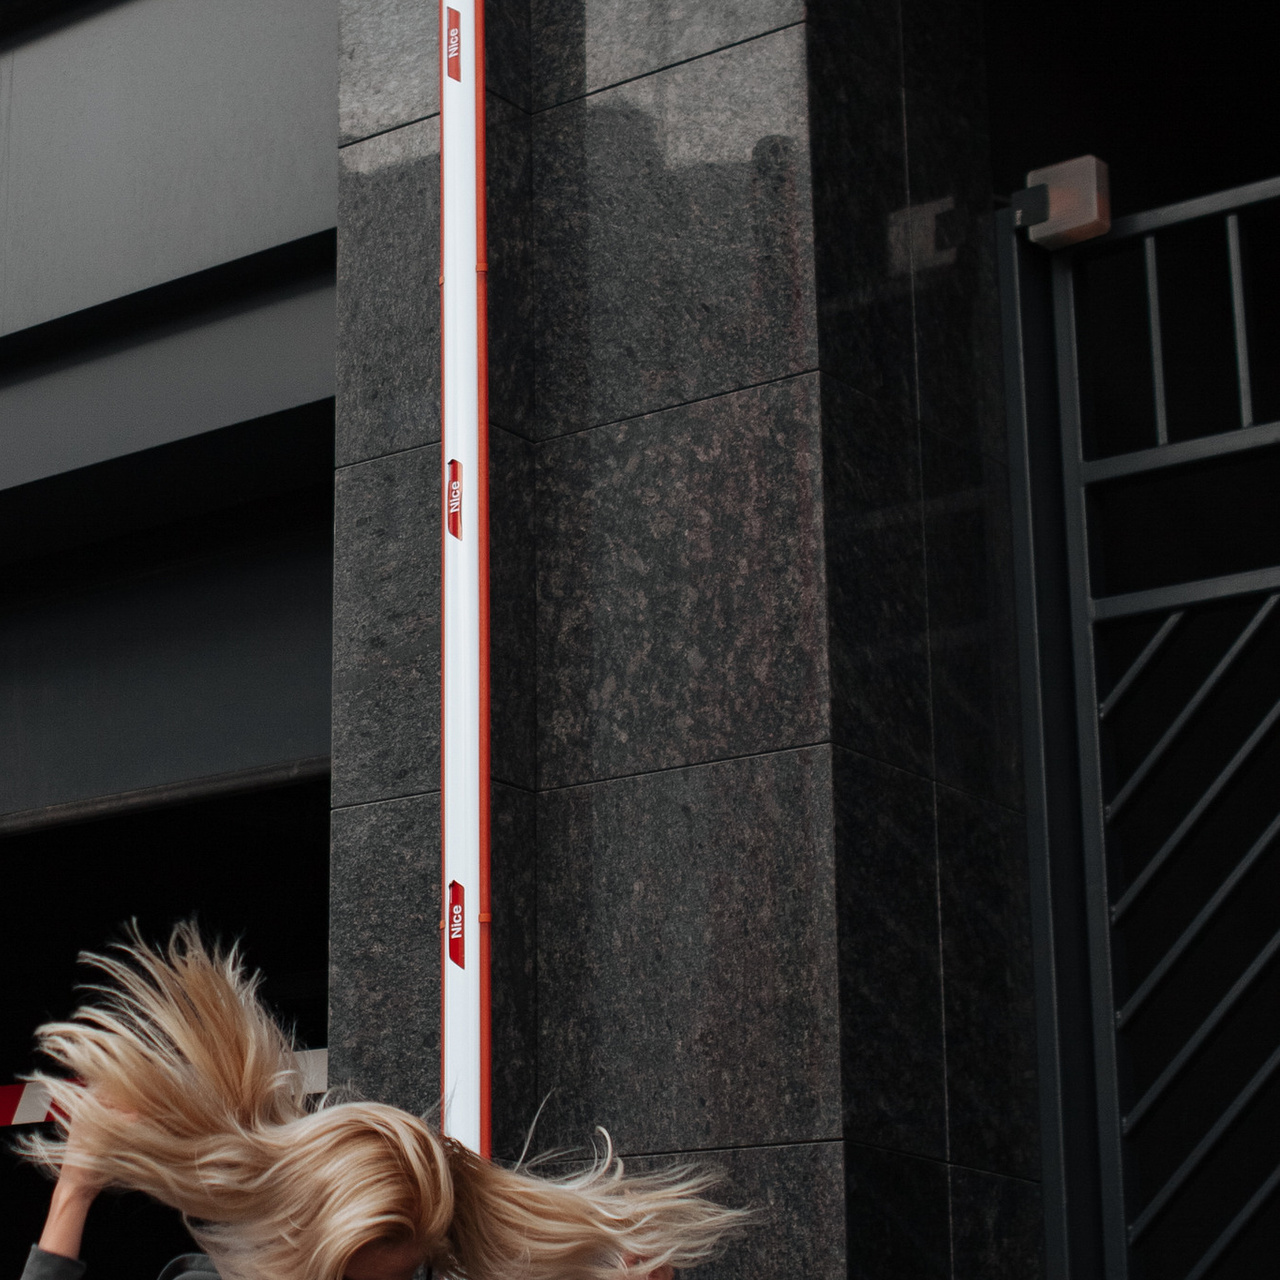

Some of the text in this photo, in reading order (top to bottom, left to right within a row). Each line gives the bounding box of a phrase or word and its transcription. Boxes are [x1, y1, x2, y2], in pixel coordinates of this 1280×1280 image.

[448, 27, 460, 59] Nice
[449, 480, 461, 514] Nice
[450, 904, 463, 940] Nice
